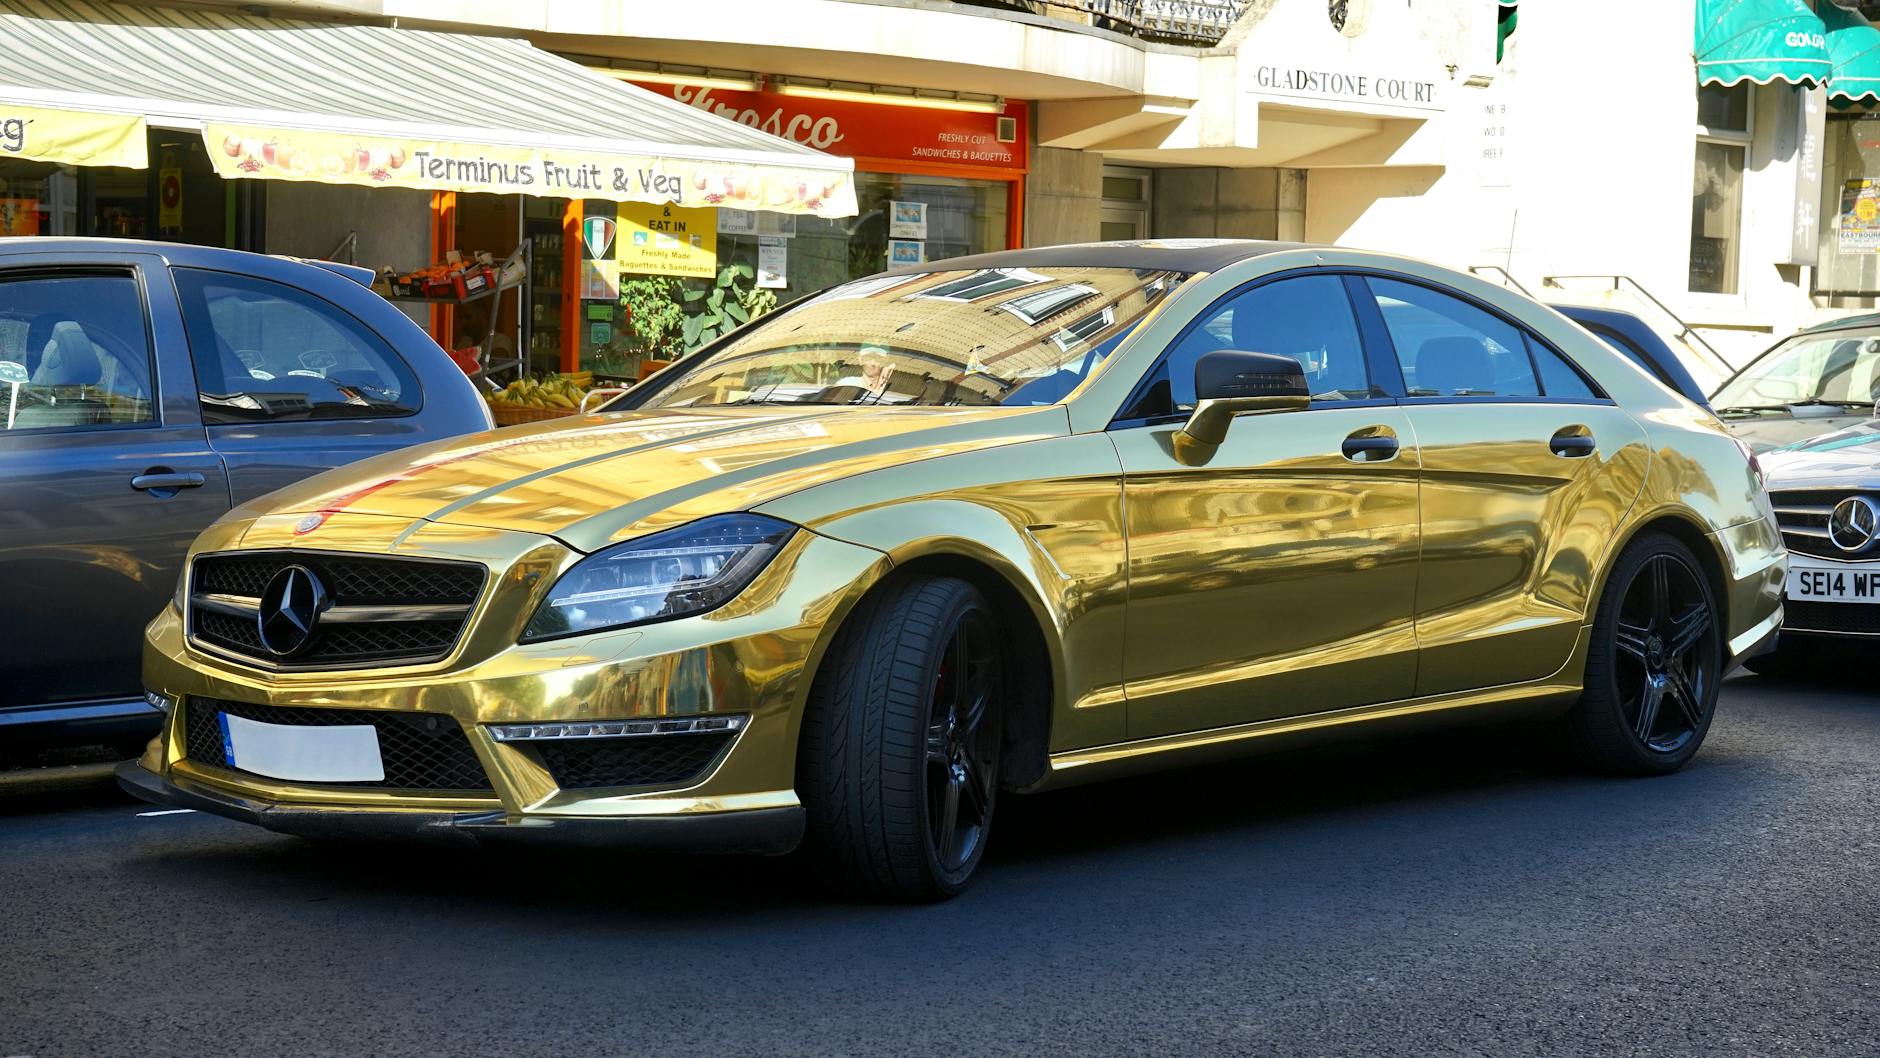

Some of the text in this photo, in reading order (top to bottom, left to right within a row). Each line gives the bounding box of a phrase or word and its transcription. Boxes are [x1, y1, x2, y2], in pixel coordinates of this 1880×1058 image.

[1257, 66, 1434, 102] GLADSTONE COURT
[938, 132, 986, 144] FRESHLY CUT
[912, 146, 1012, 162] SANDWICHES & BAGUETTES
[415, 151, 682, 204] Terminus Fruit & Veg
[663, 206, 671, 216] &
[649, 220, 686, 232] EAT IN
[641, 249, 691, 259] Freshly Made
[619, 260, 657, 270] Baguettes
[669, 263, 712, 273] Sandwiches
[1800, 571, 1846, 596] SE14
